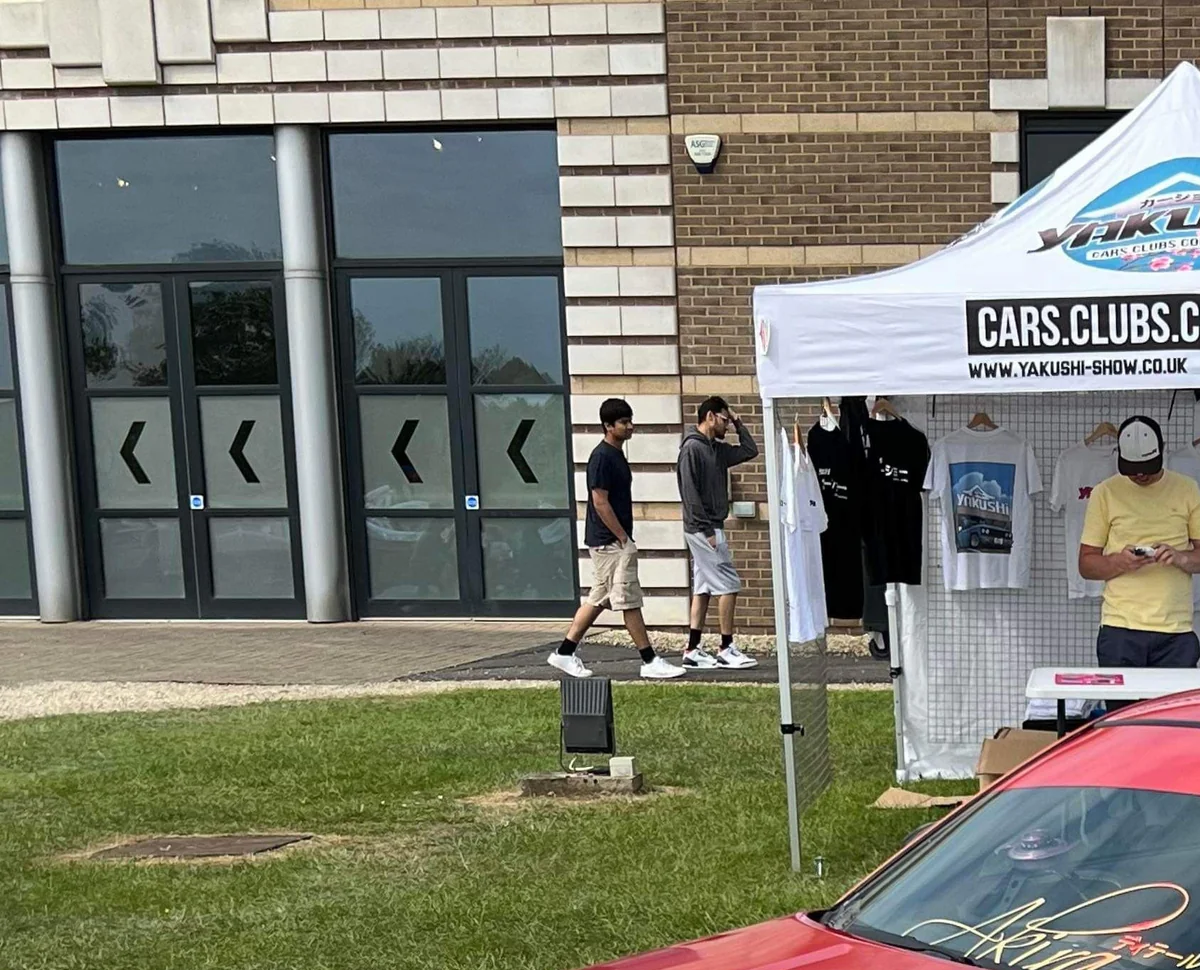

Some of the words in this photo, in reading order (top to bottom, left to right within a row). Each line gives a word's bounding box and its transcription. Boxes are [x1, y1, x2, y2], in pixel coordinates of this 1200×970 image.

[1092, 247, 1128, 259] CARS
[1132, 239, 1177, 253] CLUBS
[968, 358, 1187, 378] WWW.YAKUSHI-SHOW.CO.UK
